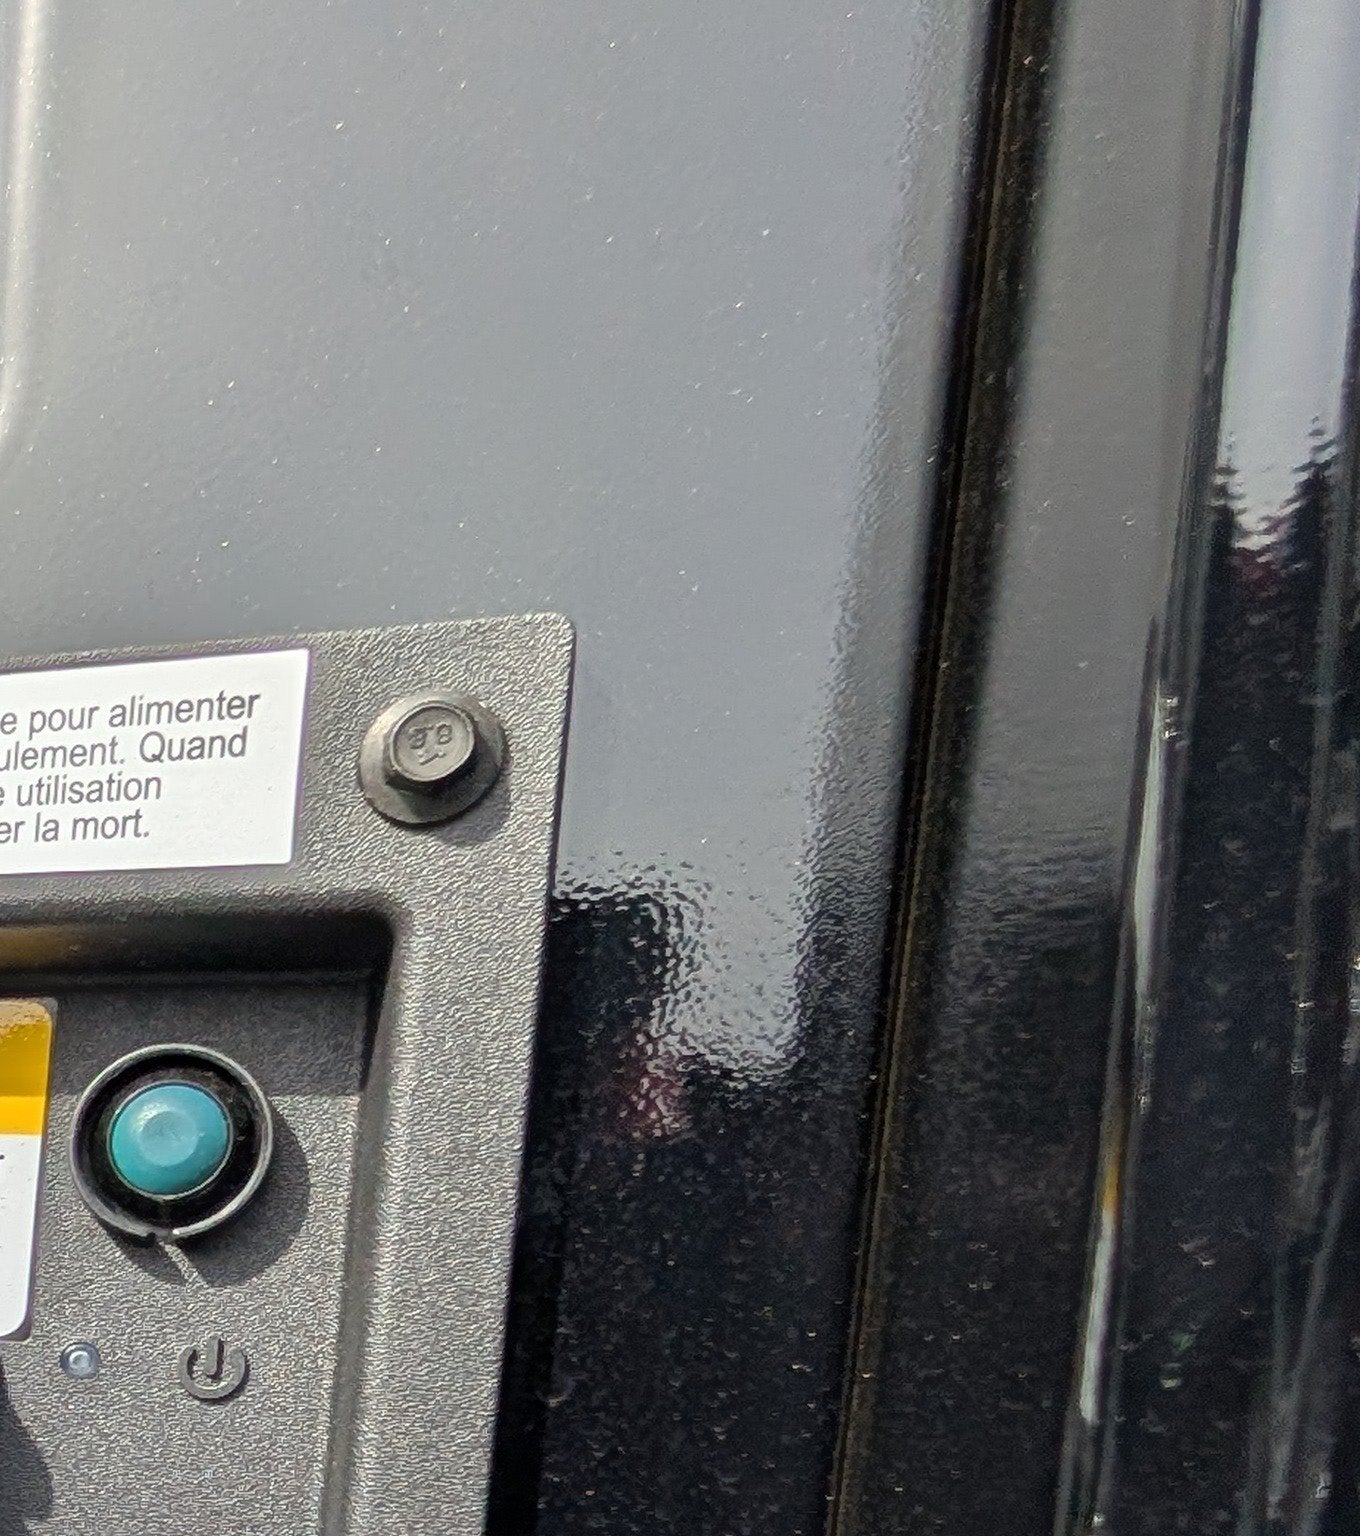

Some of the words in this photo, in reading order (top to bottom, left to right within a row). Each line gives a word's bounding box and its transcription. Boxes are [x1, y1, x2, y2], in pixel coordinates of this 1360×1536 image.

[28, 705, 101, 741] pour
[108, 689, 261, 728] alimenter
[138, 725, 249, 764] Quand
[16, 770, 162, 807] utilisation
[34, 811, 60, 843] la
[71, 807, 150, 841] mort.
